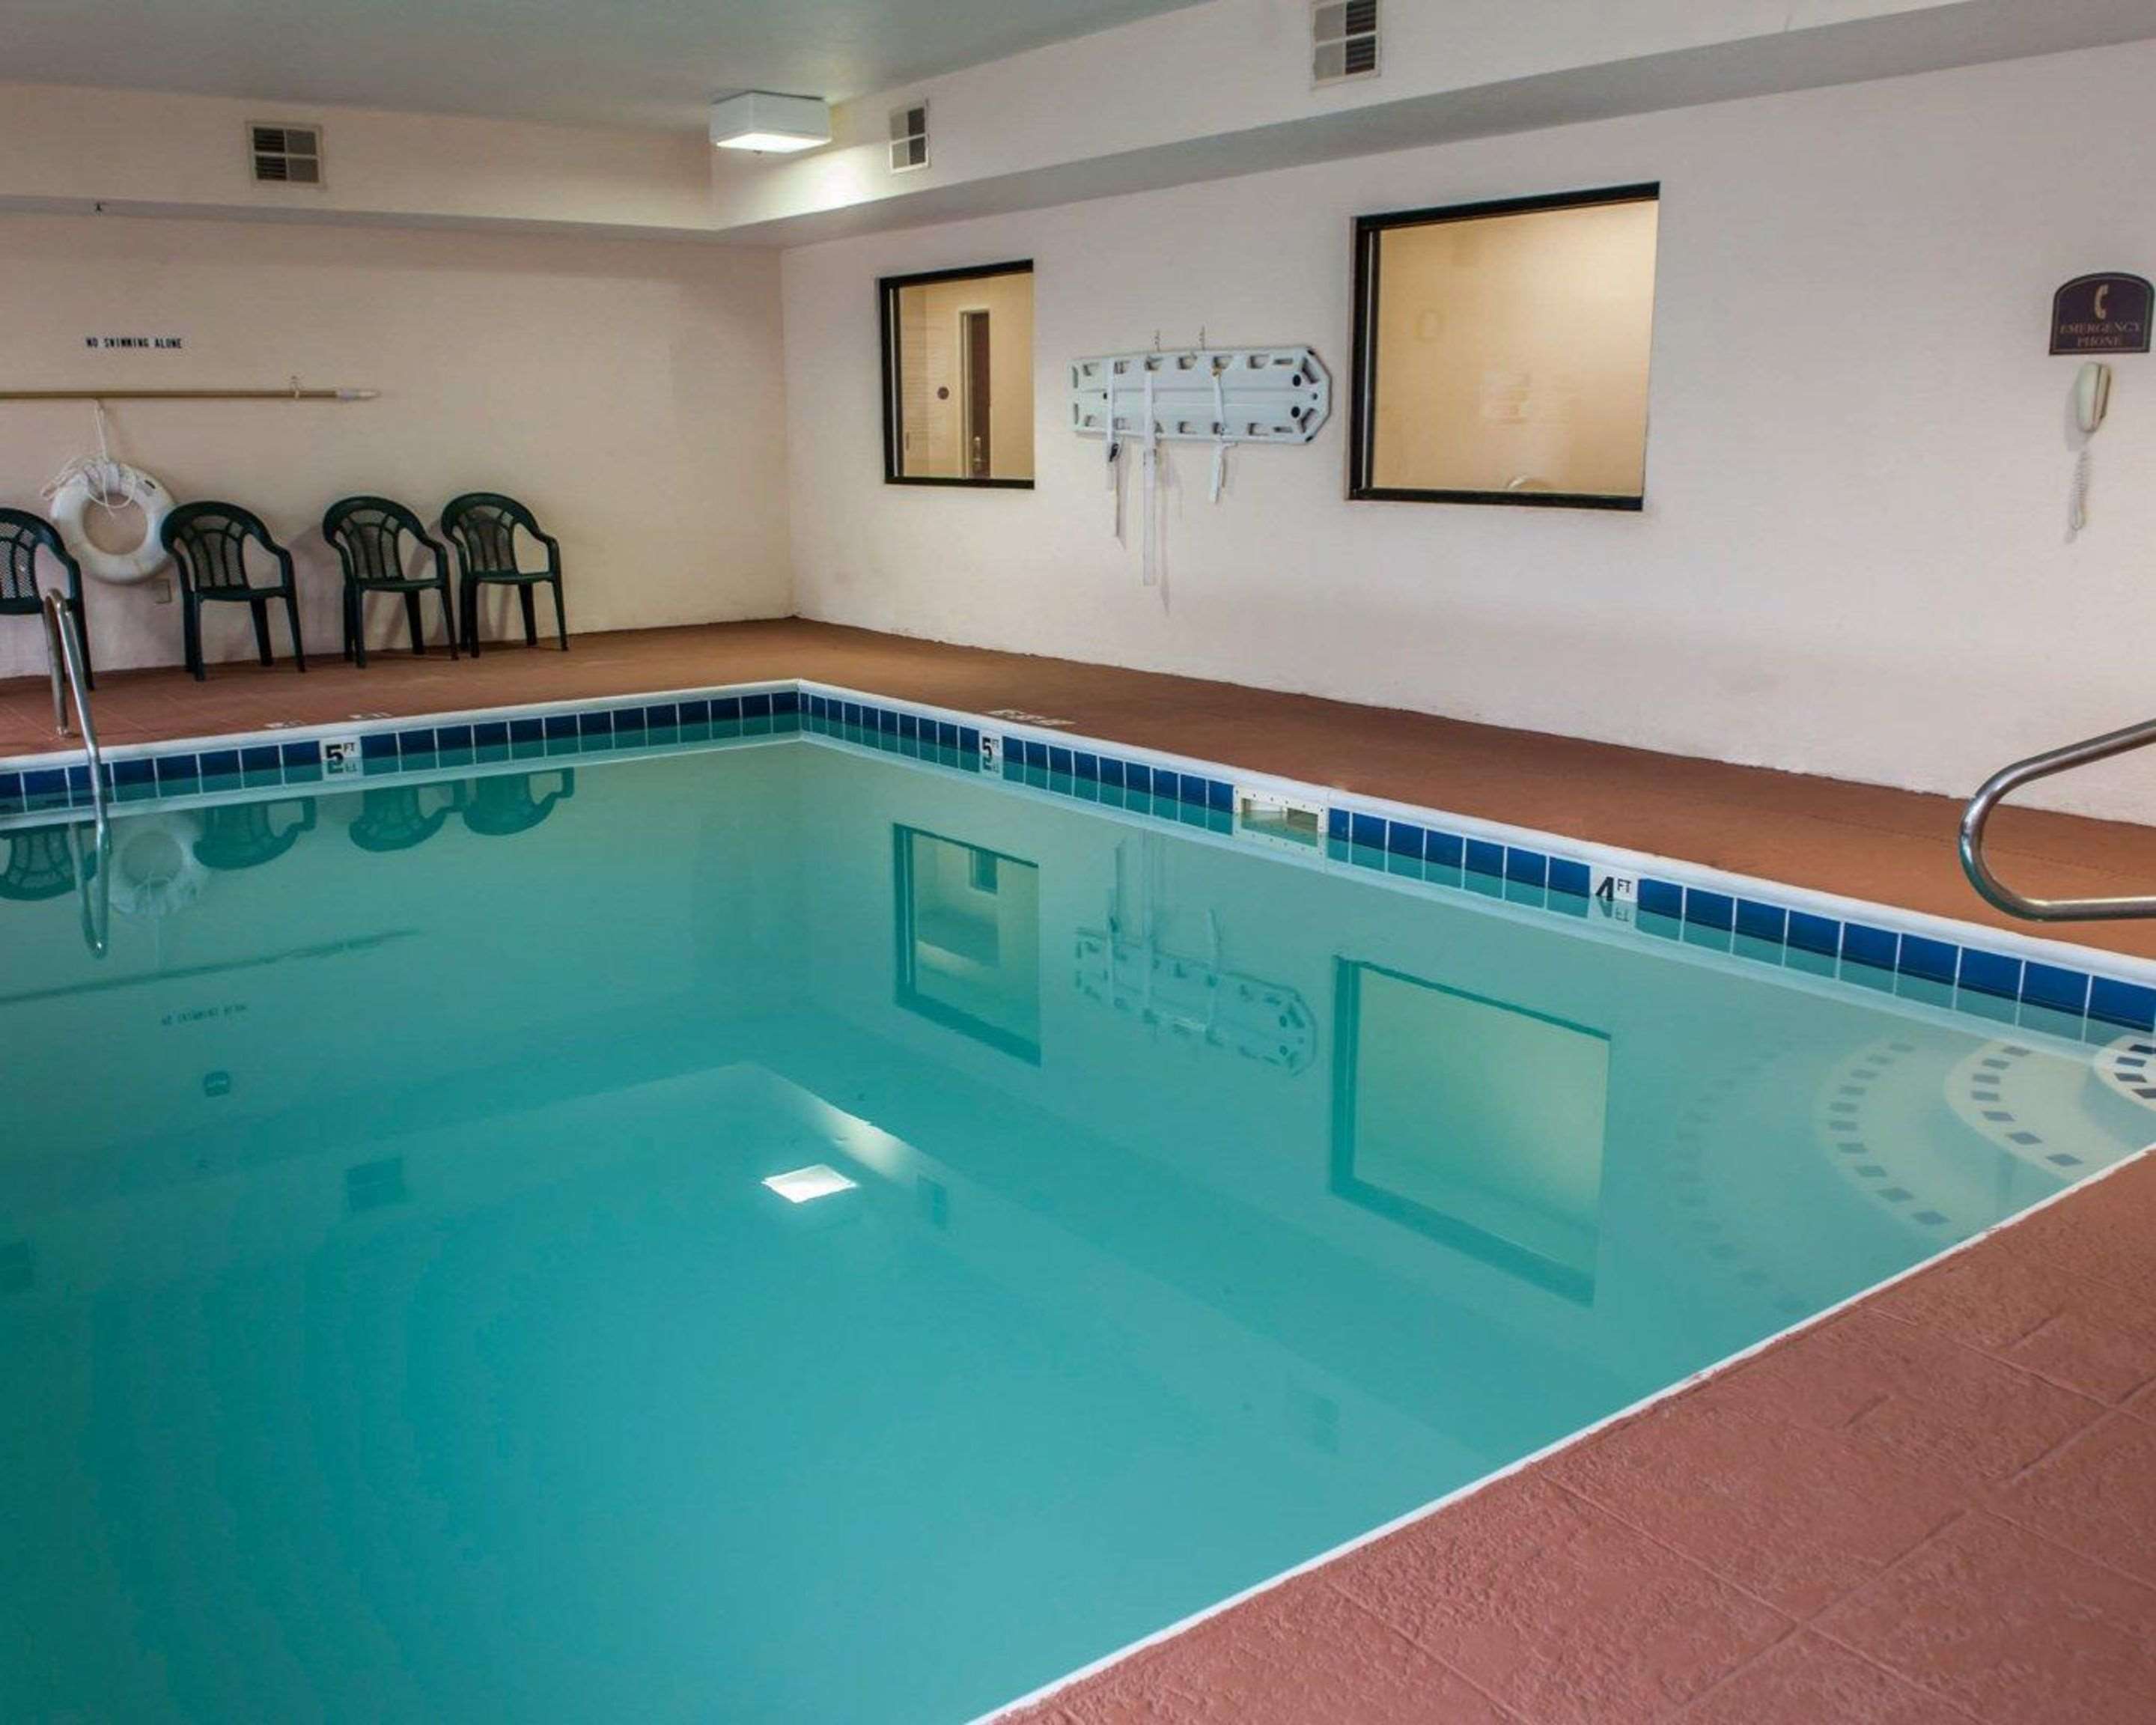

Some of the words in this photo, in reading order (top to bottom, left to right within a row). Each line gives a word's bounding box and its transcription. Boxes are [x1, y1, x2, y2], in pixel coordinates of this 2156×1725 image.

[2059, 320, 2141, 334] EMERGENCY
[85, 338, 98, 347] NO
[2077, 335, 2122, 347] PHONE
[326, 744, 344, 762] 5
[344, 742, 356, 752] FT
[982, 736, 992, 757] 5
[1595, 876, 1613, 901] 4
[1617, 878, 1631, 893] FT
